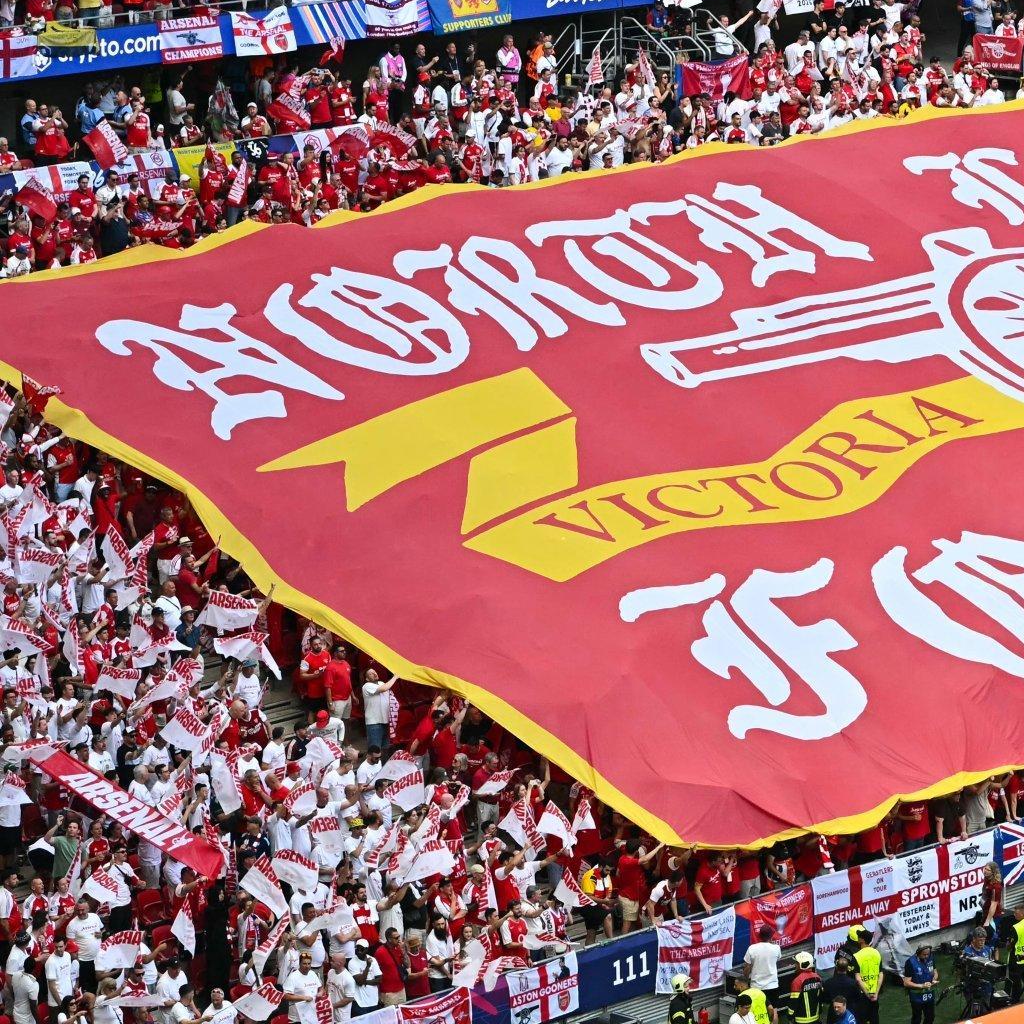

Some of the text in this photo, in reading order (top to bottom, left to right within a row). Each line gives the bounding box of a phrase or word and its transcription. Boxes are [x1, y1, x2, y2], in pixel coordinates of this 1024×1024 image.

[161, 16, 216, 32] ARSENAL
[443, 17, 494, 32] SUPPORTERS
[165, 45, 223, 61] CHAMPIONS
[138, 169, 166, 179] RSENAL
[95, 182, 874, 439] NORTH
[532, 395, 984, 542] VICTORIA
[59, 772, 177, 848] ARSENAL
[873, 883, 888, 893] TOUR
[901, 869, 985, 906] SPROWSTON
[959, 893, 982, 912] NR
[822, 899, 890, 927] ARSENAL AWAY
[899, 904, 936, 918] YESTERDAY,
[904, 915, 924, 924] TODAY
[905, 922, 930, 933] ALWAYS
[669, 945, 721, 959] THE ARSENAL
[613, 951, 650, 986] 111
[512, 976, 579, 1008] ASTON GOONERS
